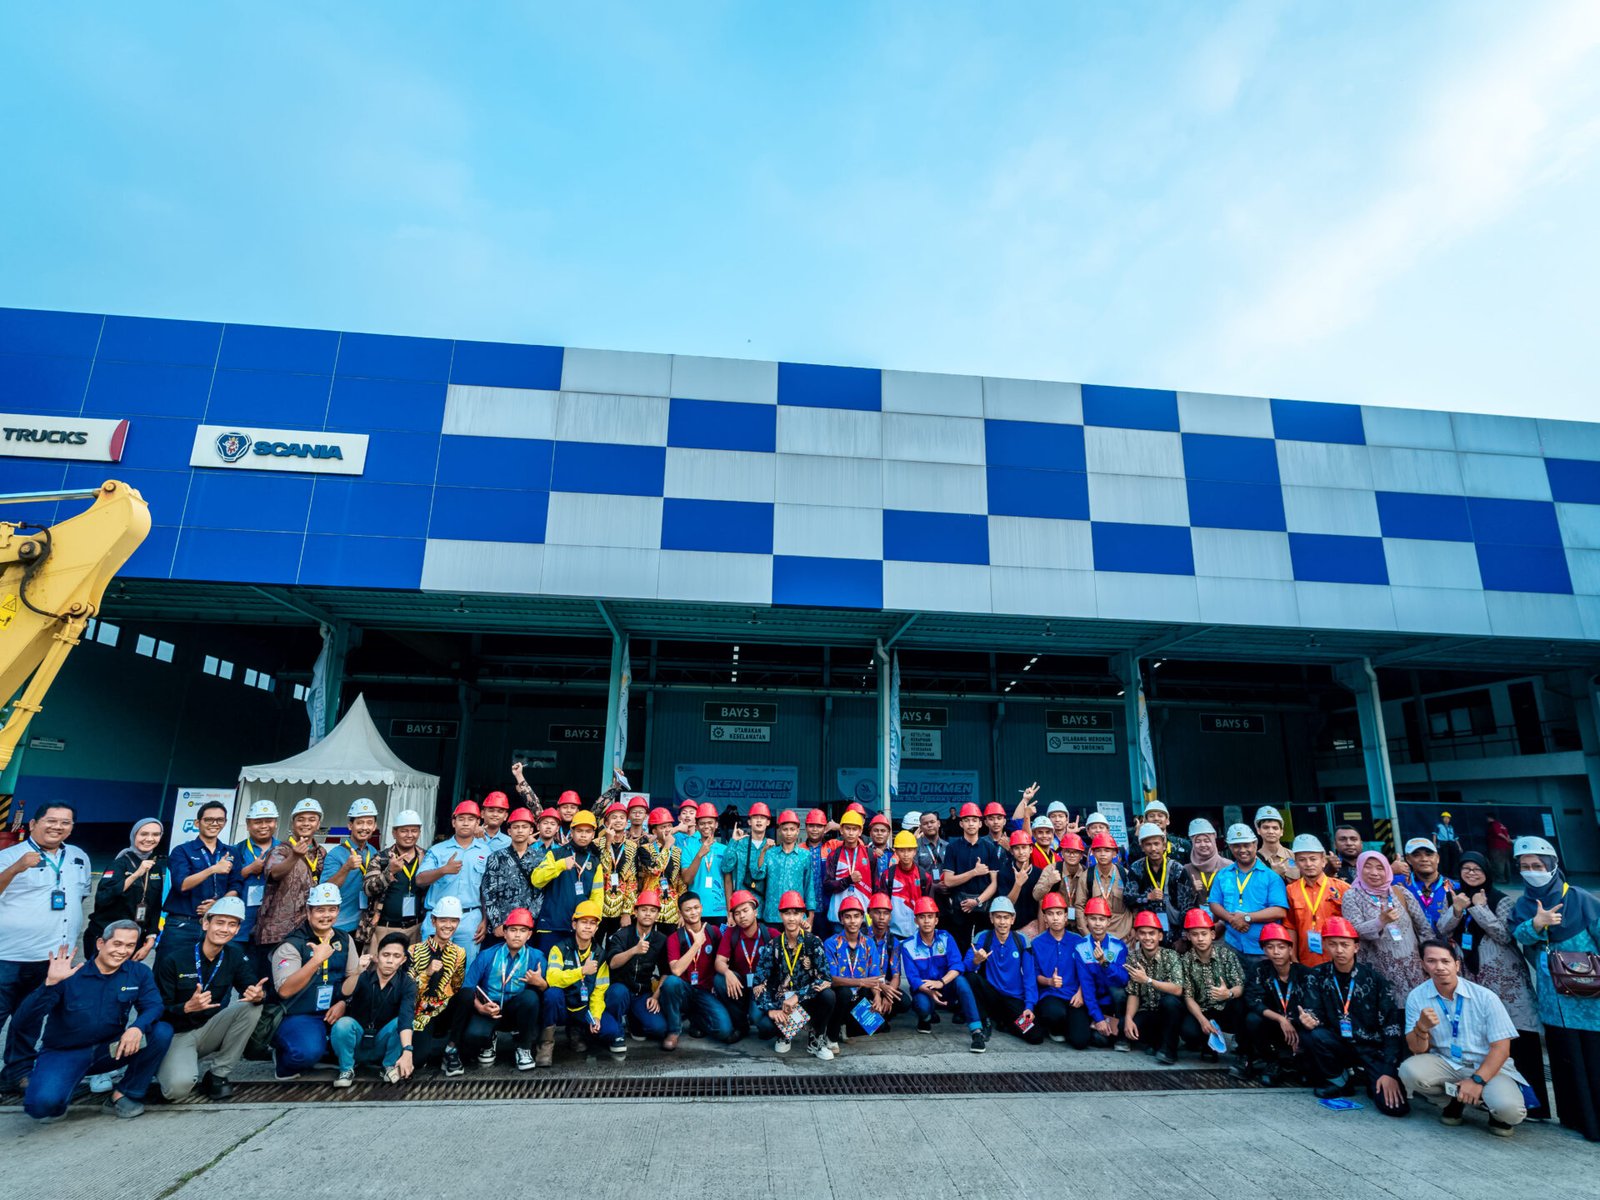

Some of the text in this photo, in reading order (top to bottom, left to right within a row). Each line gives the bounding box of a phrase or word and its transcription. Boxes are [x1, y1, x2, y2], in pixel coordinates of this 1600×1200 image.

[3, 427, 88, 445] TRUCKS
[253, 441, 343, 460] SCANIA
[721, 707, 760, 718] BAYS 3
[901, 711, 931, 722] AYS 4
[1062, 715, 1097, 725] BAYS 5
[1215, 719, 1250, 729] BAYS 6
[406, 724, 441, 735] BAYS 1
[564, 729, 599, 739] BAYS 2
[707, 779, 793, 791] LKSN DIKMEN
[898, 783, 972, 794] SN DIKMEN
